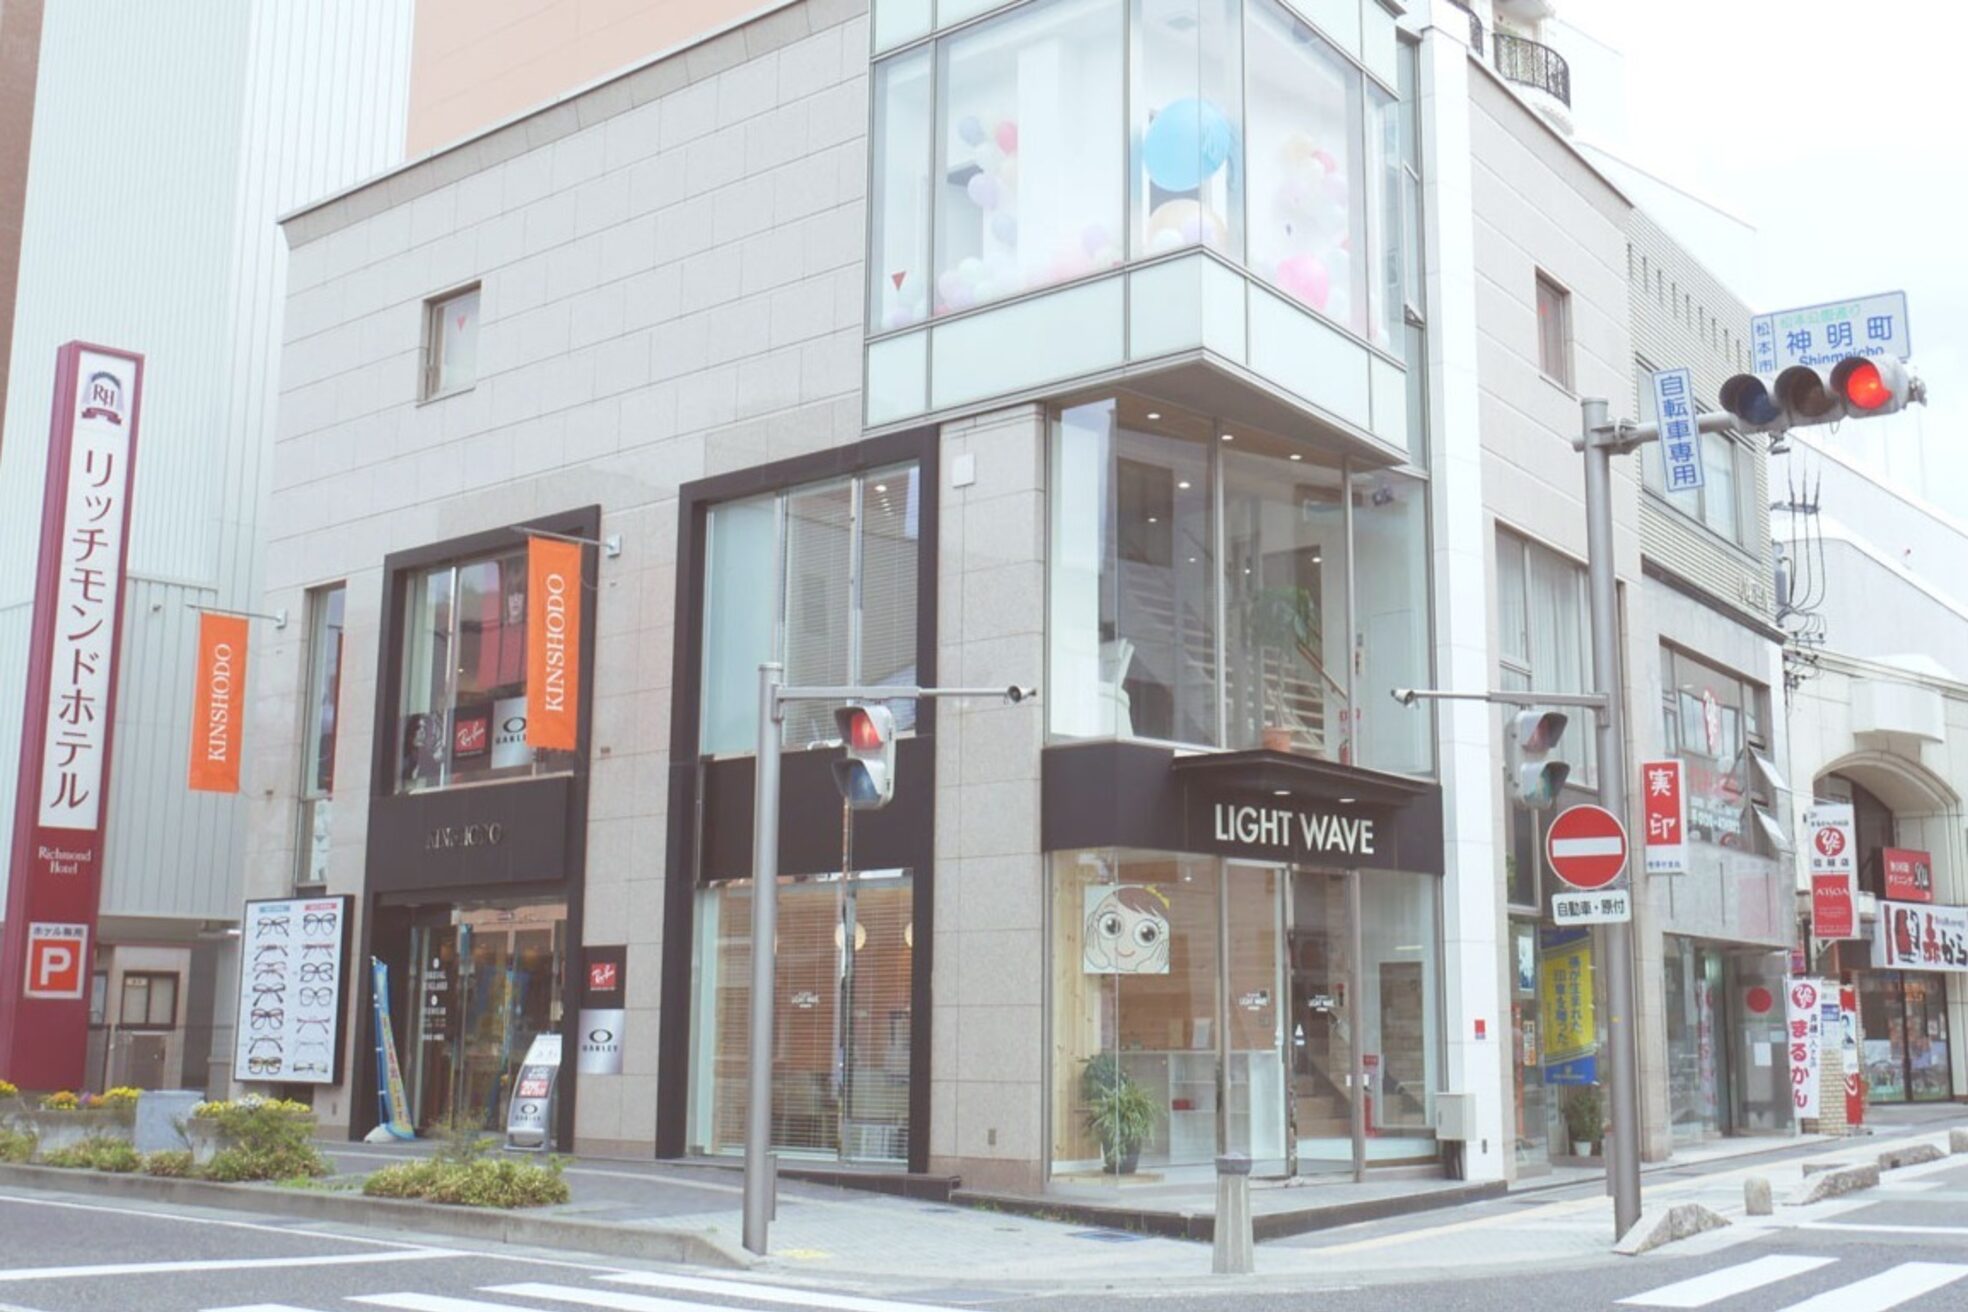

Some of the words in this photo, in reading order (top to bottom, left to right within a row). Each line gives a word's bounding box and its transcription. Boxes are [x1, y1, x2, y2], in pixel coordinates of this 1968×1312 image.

[1756, 321, 1773, 372] 松本市
[1787, 315, 1893, 355] 神明町
[1661, 375, 1697, 486] 自転車専用
[50, 450, 113, 809] リッチモンドホテル
[545, 574, 566, 712] KINSHODO
[207, 643, 232, 762] KINSHODO
[1215, 803, 1293, 846] LIGHT
[1299, 812, 1375, 855] WAVE
[1649, 768, 1676, 840] 実印
[38, 846, 91, 862] Richmond
[50, 862, 77, 874] Hotel
[40, 947, 71, 985] P
[1790, 1019, 1810, 1108] まるかん
